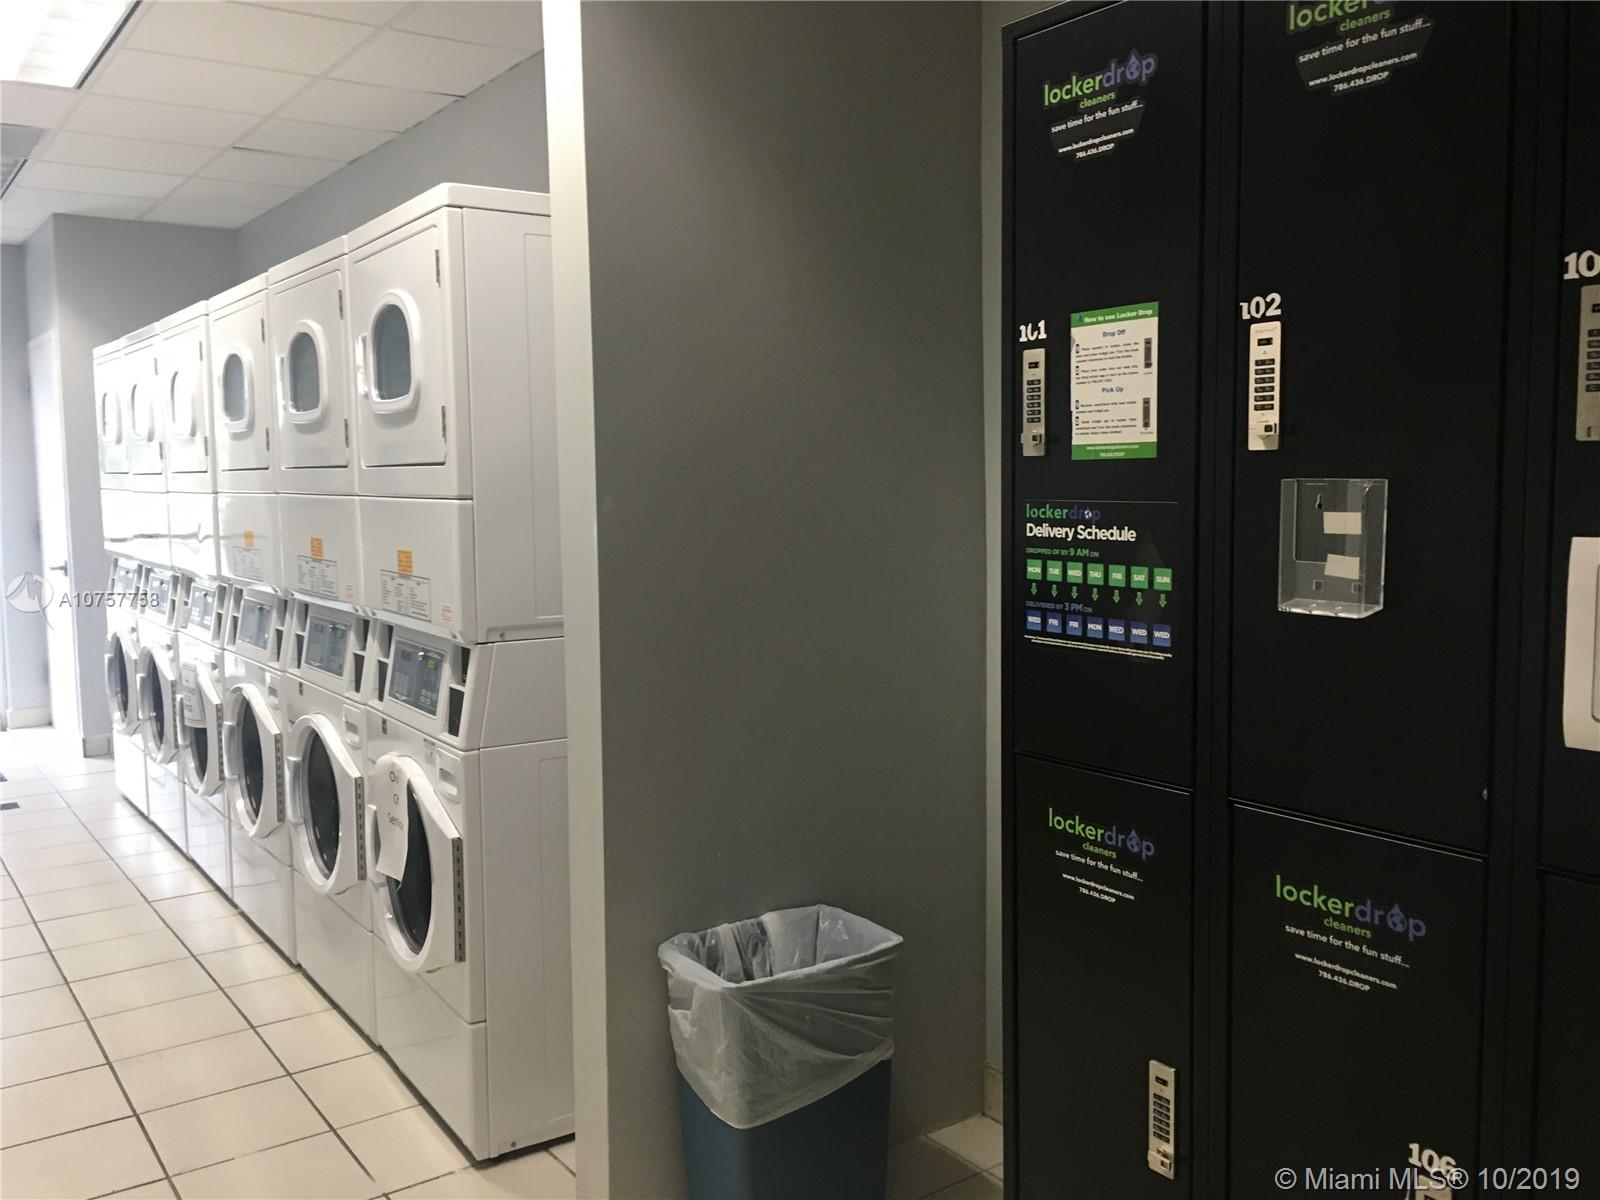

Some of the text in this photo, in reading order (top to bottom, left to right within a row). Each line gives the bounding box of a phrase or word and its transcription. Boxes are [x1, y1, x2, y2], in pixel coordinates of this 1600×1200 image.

[1340, 9, 1391, 31] cleaners
[1298, 51, 1320, 63] save
[1322, 44, 1344, 56] time
[1345, 37, 1360, 49] for
[1362, 32, 1378, 44] the
[1380, 27, 1398, 39] fun
[1044, 54, 1155, 106] lockerdrop
[1308, 52, 1418, 86] www.lockerdropcleaners.com
[1334, 71, 1390, 92] 786.436.DROP
[1080, 92, 1116, 108] cleaners
[1051, 124, 1066, 133] save
[1067, 118, 1083, 128] time
[1084, 114, 1094, 123] for
[1095, 110, 1107, 120] the
[1108, 106, 1120, 116] fun
[1239, 292, 1282, 320] 102
[1026, 504, 1100, 522] lockerdrop
[1026, 524, 1136, 542] Delivery Schedule
[1069, 548, 1075, 556] 9
[1076, 548, 1089, 557] AM
[1068, 569, 1081, 577] WED
[1089, 570, 1102, 578] THU
[1133, 574, 1146, 582] SAT
[1156, 576, 1170, 584] SUN
[1064, 602, 1070, 611] 3
[1070, 603, 1082, 612] PM
[1028, 616, 1170, 639] WED FRI FRI MON WED WED WED
[1048, 808, 1154, 860] lockerdrop
[1082, 842, 1117, 858] cleaners
[1056, 850, 1070, 859] save
[1071, 853, 1086, 864] time
[1086, 857, 1096, 866] for
[1098, 860, 1108, 870] the
[1110, 864, 1121, 874] fun
[1276, 874, 1426, 942] lockerdrop
[1324, 917, 1372, 938] cleaners
[1285, 925, 1305, 937] save
[1306, 930, 1328, 943] time
[1329, 935, 1343, 947] for
[1344, 940, 1360, 953] the
[1362, 945, 1378, 958] fun
[1318, 969, 1371, 992] 786.436.DROP
